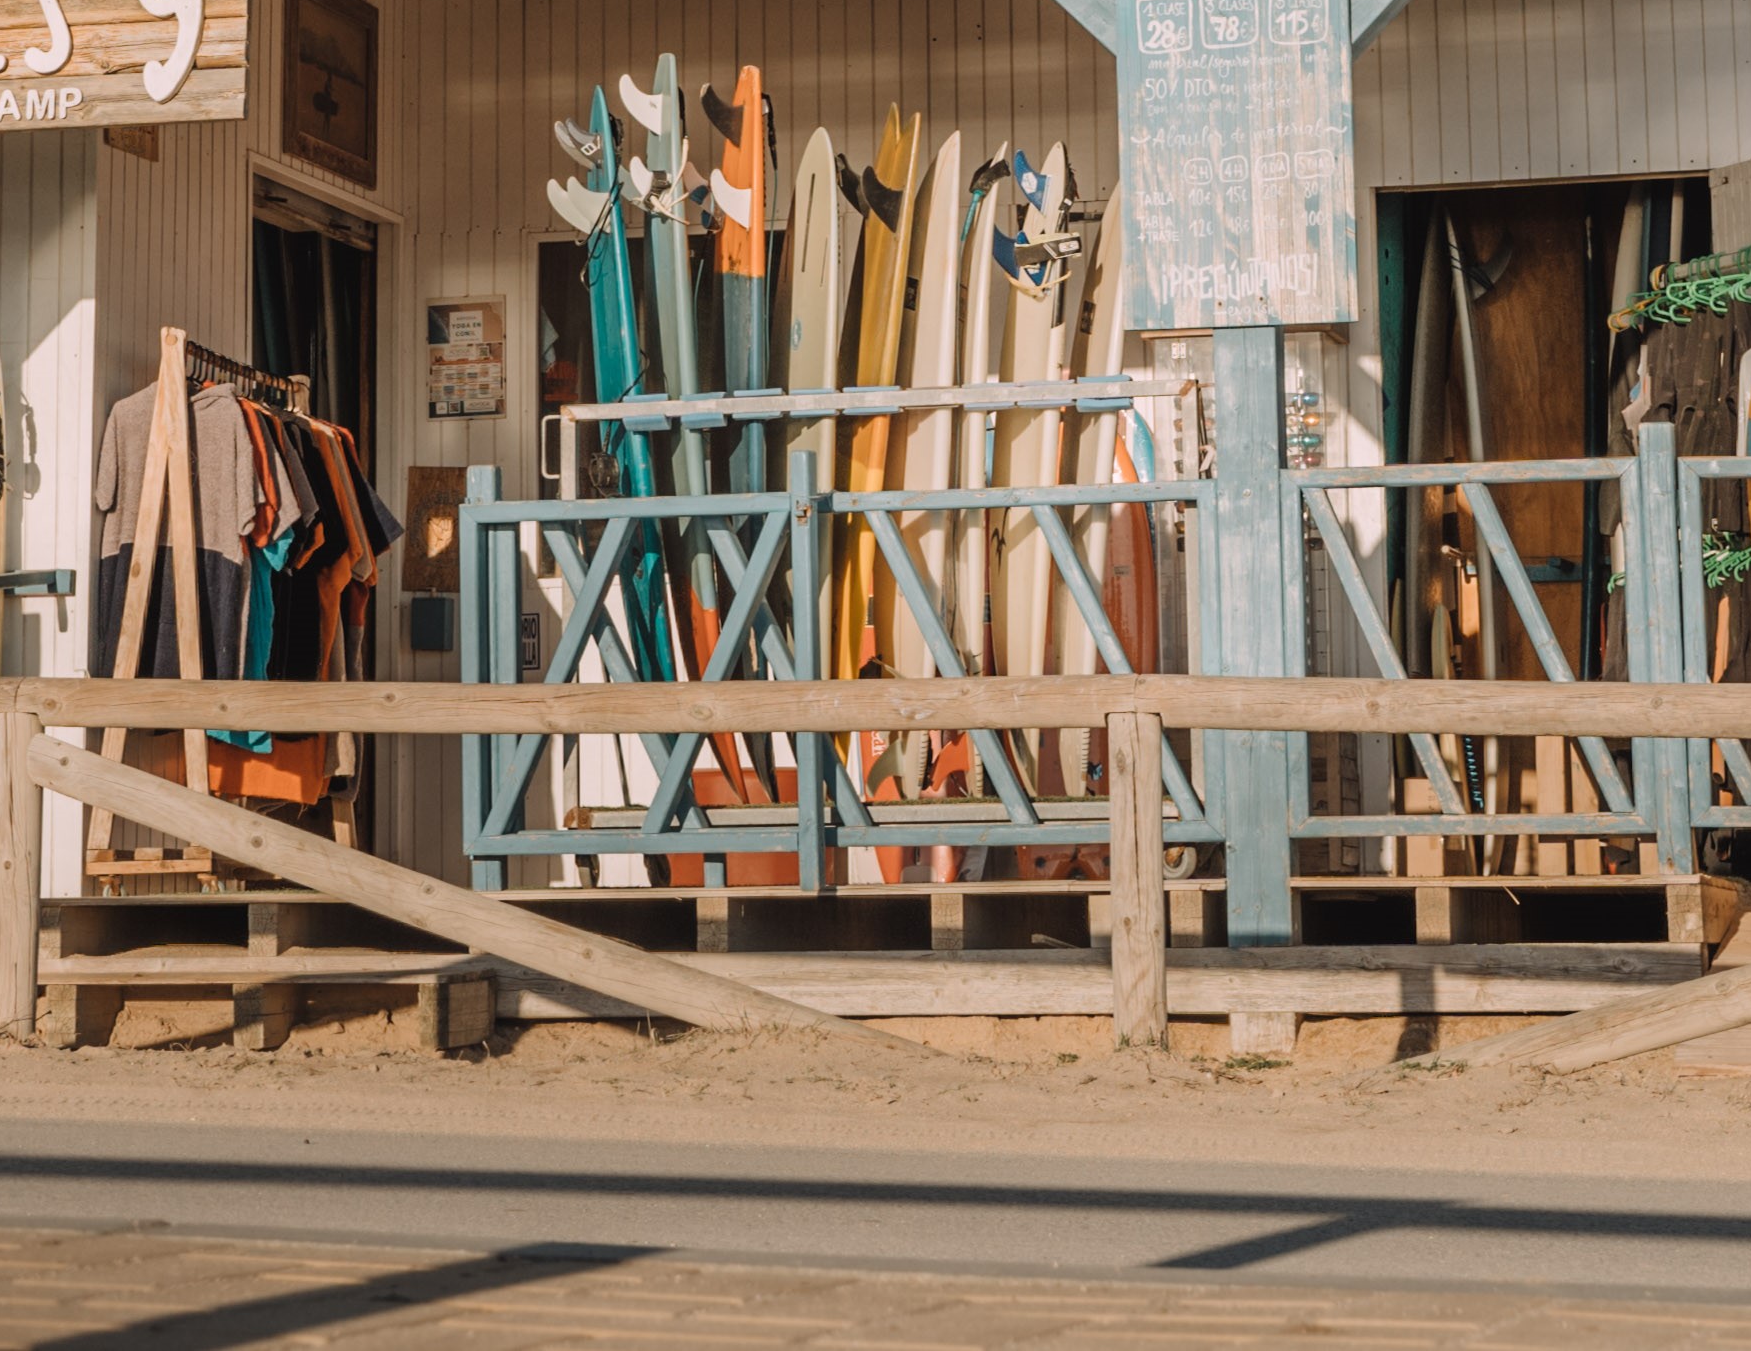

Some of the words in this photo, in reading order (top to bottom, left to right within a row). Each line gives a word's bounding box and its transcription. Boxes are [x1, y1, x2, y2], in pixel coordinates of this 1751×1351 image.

[1156, 2, 1186, 16] CLASE
[1204, 0, 1215, 13] 3
[1184, 78, 1212, 98] DTO
